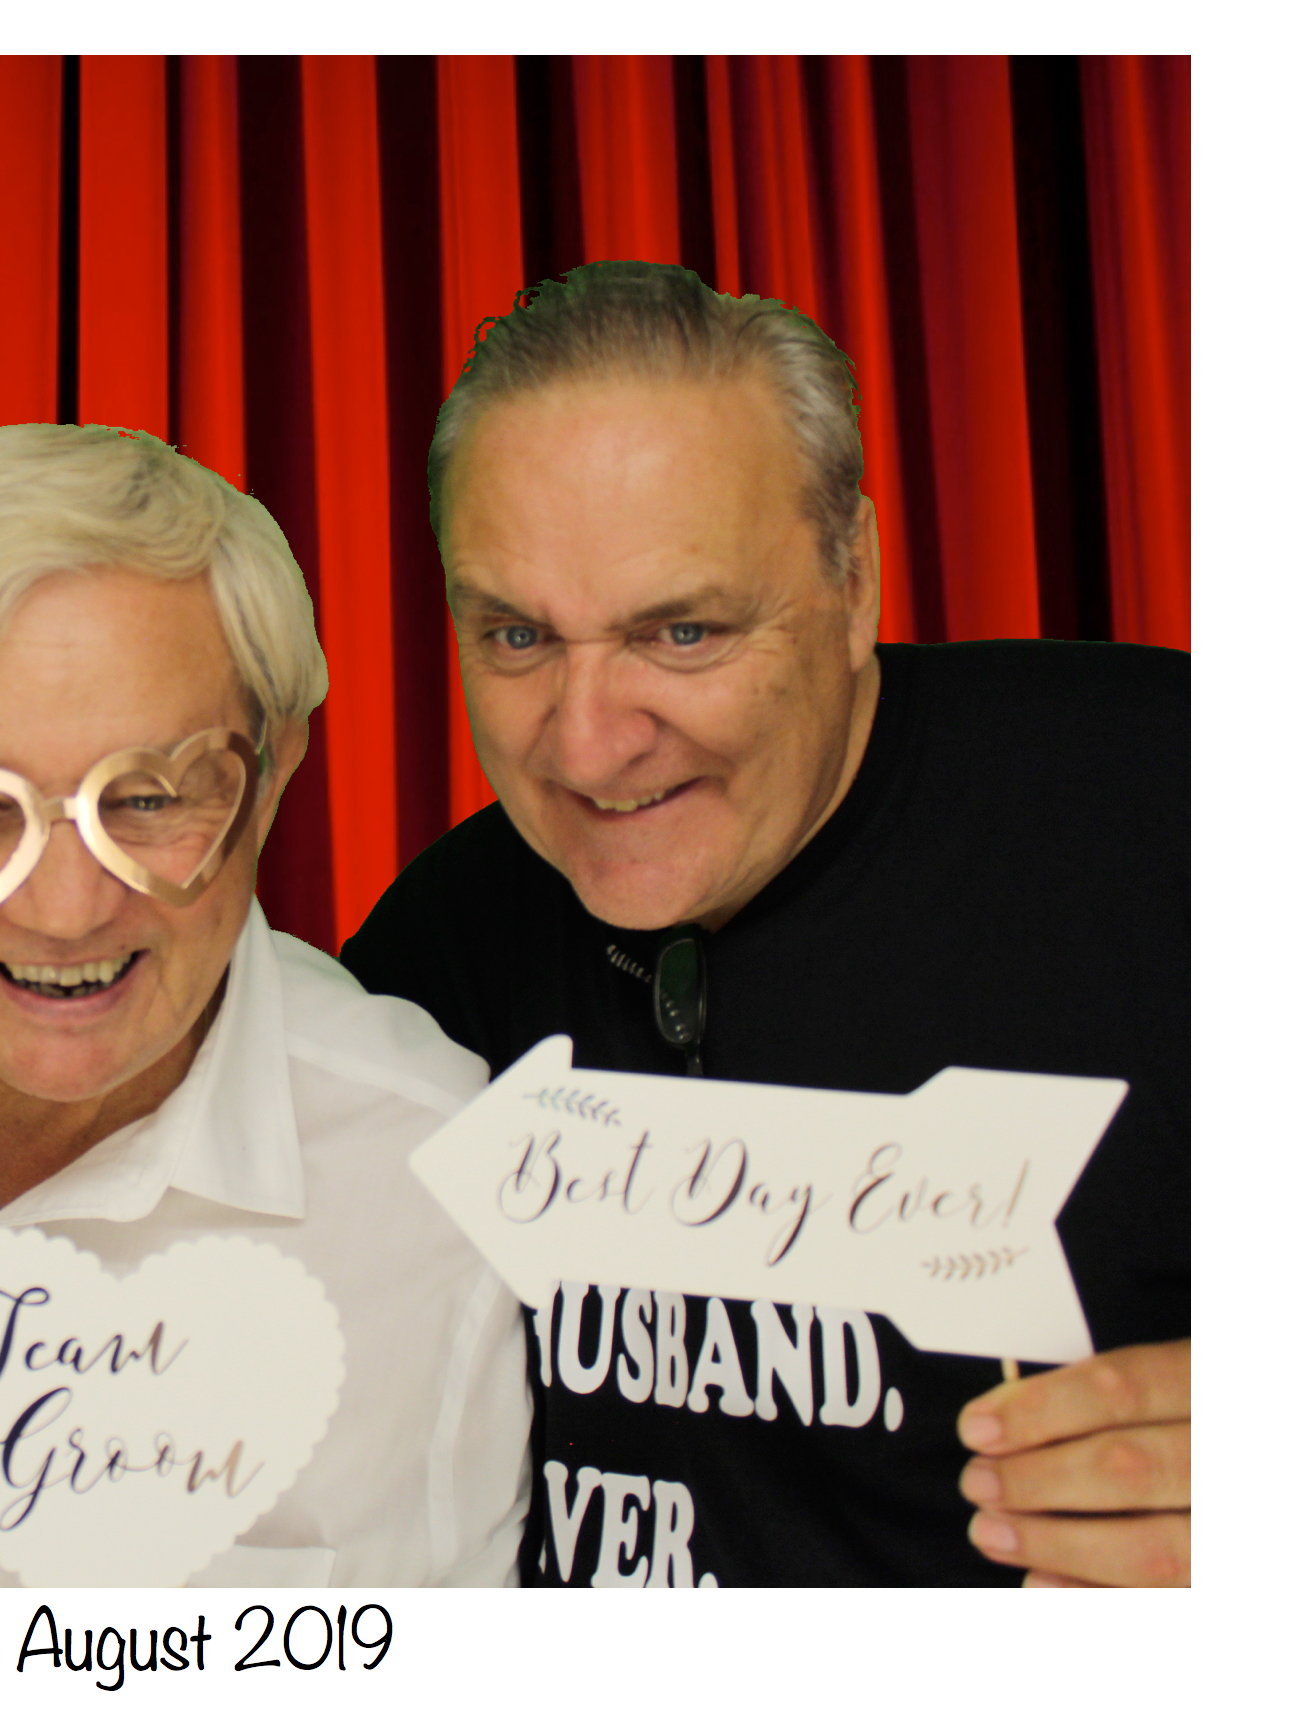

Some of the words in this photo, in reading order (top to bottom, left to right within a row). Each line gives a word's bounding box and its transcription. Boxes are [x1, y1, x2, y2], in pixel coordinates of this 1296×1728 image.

[498, 1129, 654, 1224] Best
[671, 1138, 831, 1268] Day
[848, 1141, 1031, 1234] Ever!
[538, 1460, 719, 1588] VER
